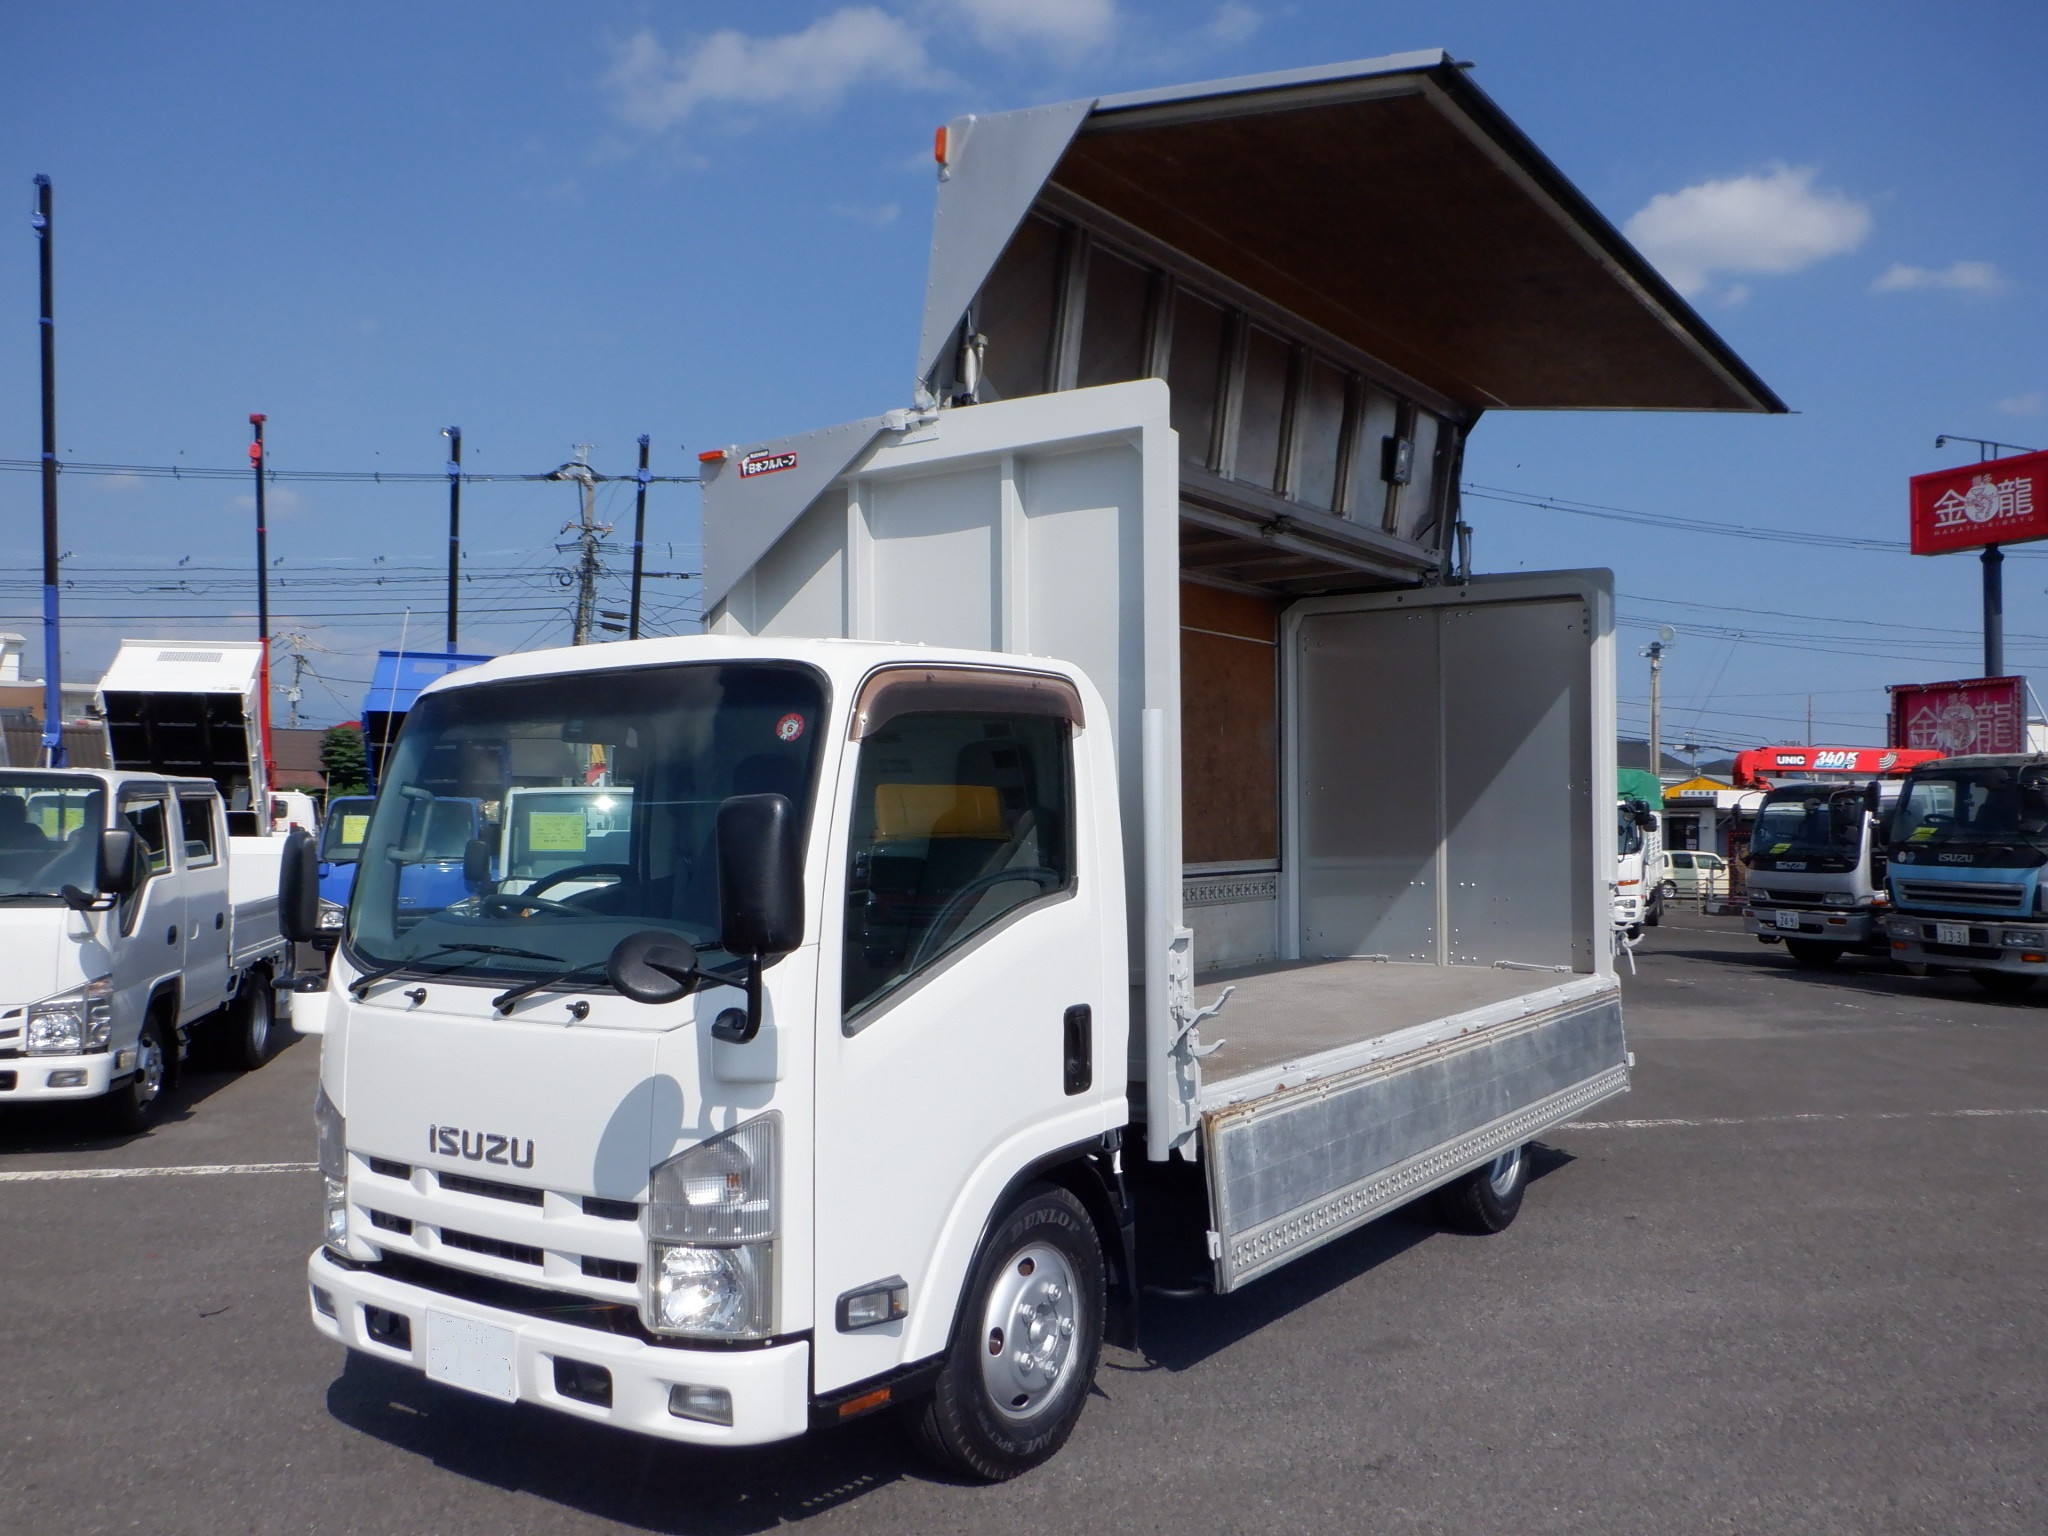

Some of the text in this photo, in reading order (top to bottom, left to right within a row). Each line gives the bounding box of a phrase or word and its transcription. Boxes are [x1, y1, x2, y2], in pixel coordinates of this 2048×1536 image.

[748, 454, 796, 474] 日本フルハーフ
[1776, 755, 1806, 765] UNIC
[1938, 853, 1974, 863] ISUZU
[429, 1123, 535, 1169] ISUZU
